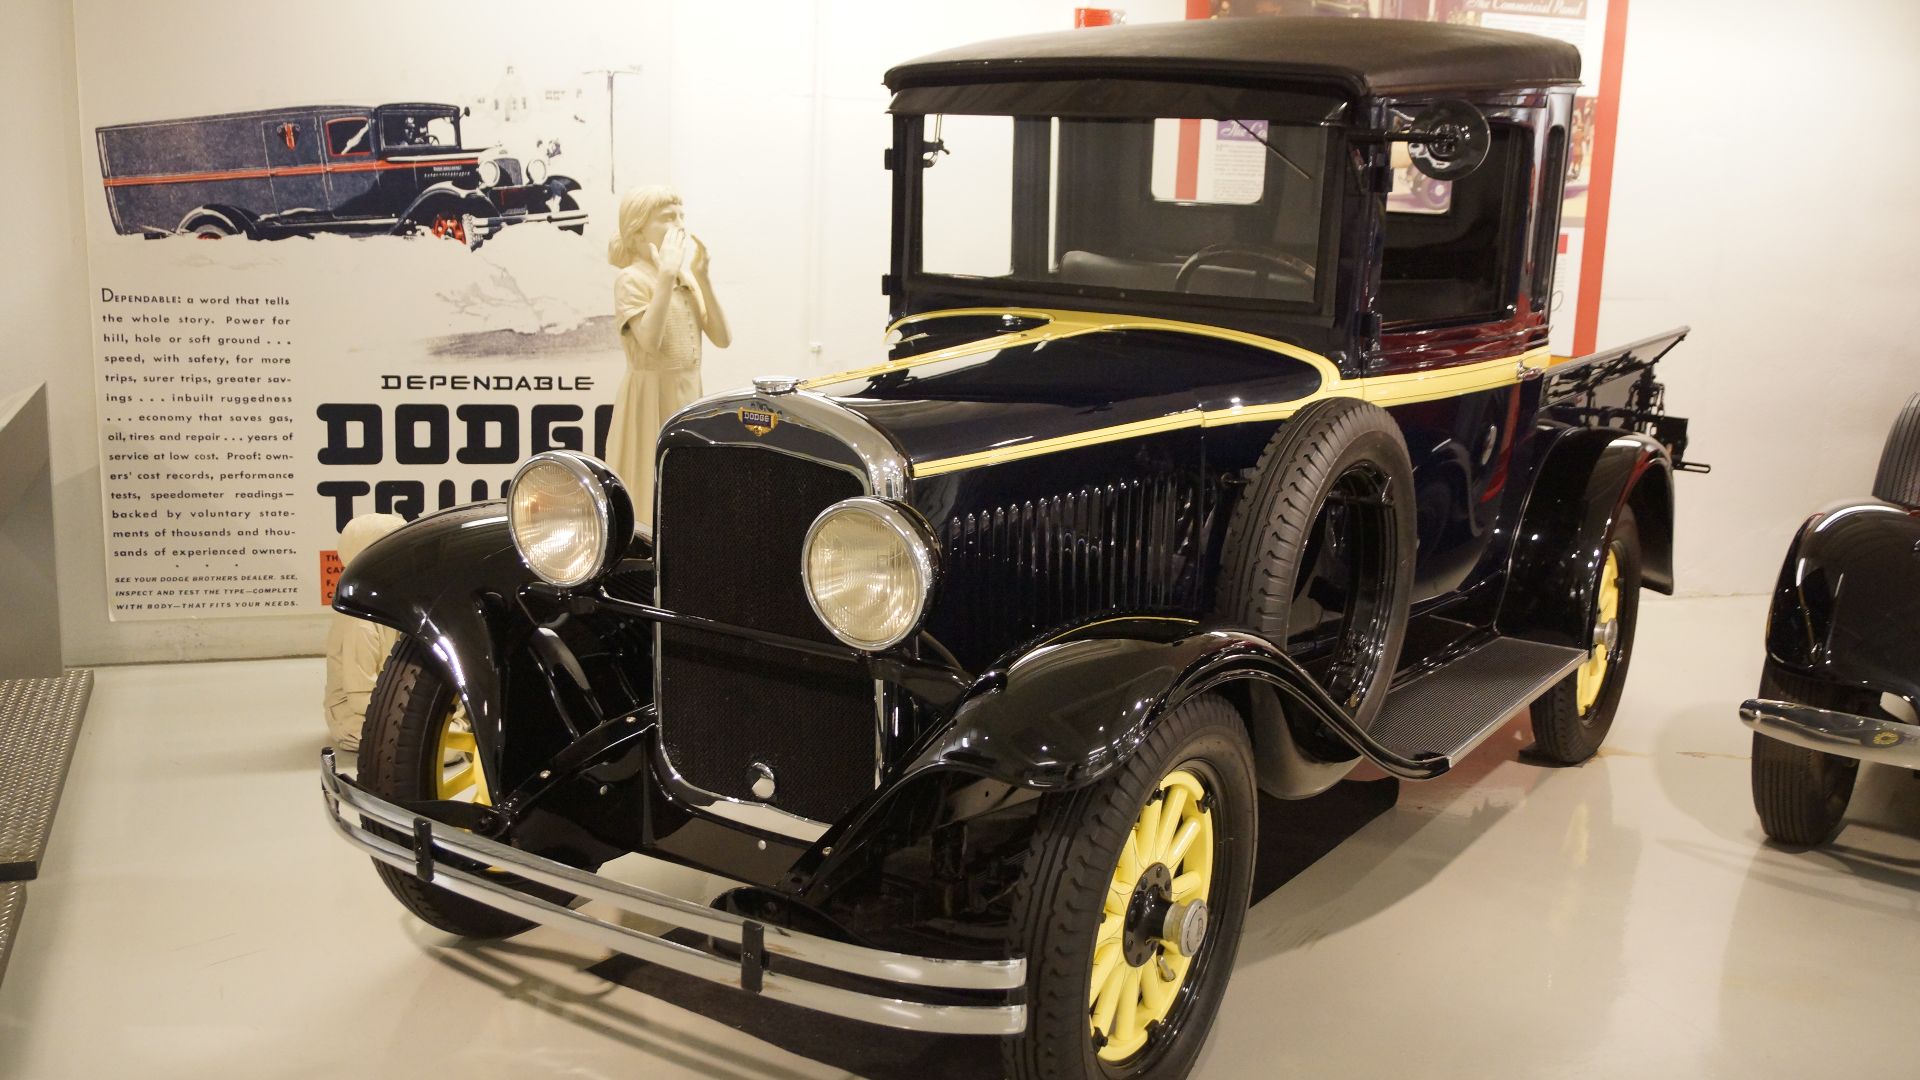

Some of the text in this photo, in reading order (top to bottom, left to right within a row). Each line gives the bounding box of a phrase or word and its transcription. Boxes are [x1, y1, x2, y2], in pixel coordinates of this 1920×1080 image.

[199, 296, 230, 304] word
[235, 296, 260, 304] that
[265, 297, 290, 305] tells
[102, 314, 292, 326] the whole story. Power for
[103, 333, 129, 344] hill,
[134, 334, 162, 342] hole
[188, 335, 211, 343] soft
[217, 336, 261, 346] ground
[104, 354, 146, 364] speed,
[152, 354, 180, 362] with
[187, 354, 230, 365] safety,
[235, 355, 254, 363] for
[104, 374, 137, 384] trips,
[180, 374, 212, 384] trips,
[216, 376, 262, 384] greater
[381, 375, 595, 391] DEPENDABLE
[105, 393, 133, 403] ings
[171, 394, 215, 402] inbuilt
[220, 394, 293, 404] ruggedness
[138, 415, 193, 423] economy
[199, 413, 223, 421] that
[268, 416, 293, 424] gas,
[744, 412, 770, 422] DODGE
[107, 432, 127, 442] oil,
[159, 432, 182, 440] and
[185, 433, 221, 443] repair
[246, 435, 278, 443] years
[282, 432, 295, 440] of
[108, 452, 150, 460] service
[169, 452, 190, 460] low
[226, 452, 262, 460] Proof:
[109, 472, 133, 480] ers'
[165, 471, 215, 480] records,
[219, 471, 295, 481] performance
[110, 492, 142, 500] tests,
[150, 490, 225, 501] speedometer
[111, 510, 158, 518] backed
[166, 510, 182, 520] by
[189, 509, 251, 519] voluntary
[154, 528, 168, 537] of
[171, 528, 232, 536] thousands
[237, 528, 259, 536] and
[264, 528, 296, 536] thou-
[113, 548, 149, 557] sands
[153, 547, 167, 556] of
[171, 547, 246, 558] experienced
